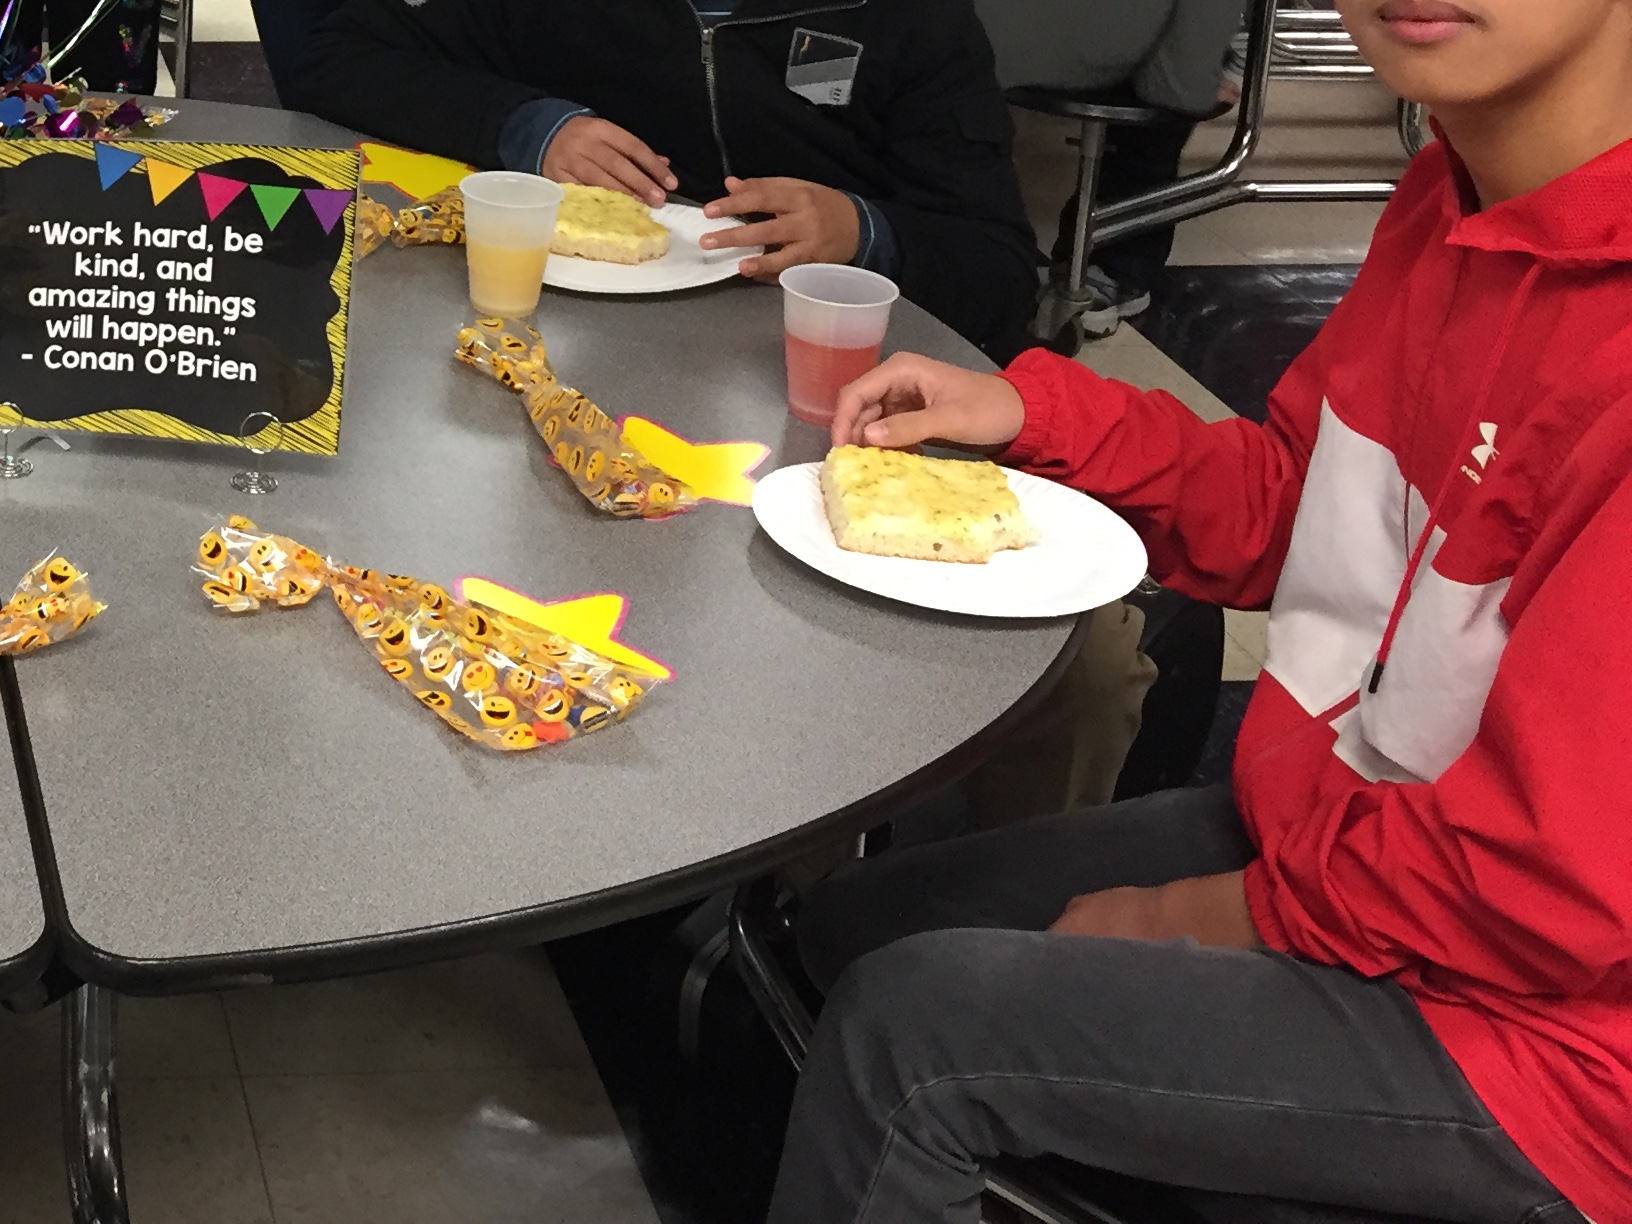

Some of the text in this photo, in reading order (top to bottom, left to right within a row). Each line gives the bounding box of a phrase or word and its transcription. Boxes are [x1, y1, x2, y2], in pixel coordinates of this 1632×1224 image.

[133, 221, 214, 253] hard,
[224, 226, 264, 253] be
[75, 251, 214, 282] kind, and
[28, 285, 257, 322] amazing things
[46, 314, 93, 338] will
[44, 345, 134, 371] Conan
[144, 349, 257, 382] O'Brien
